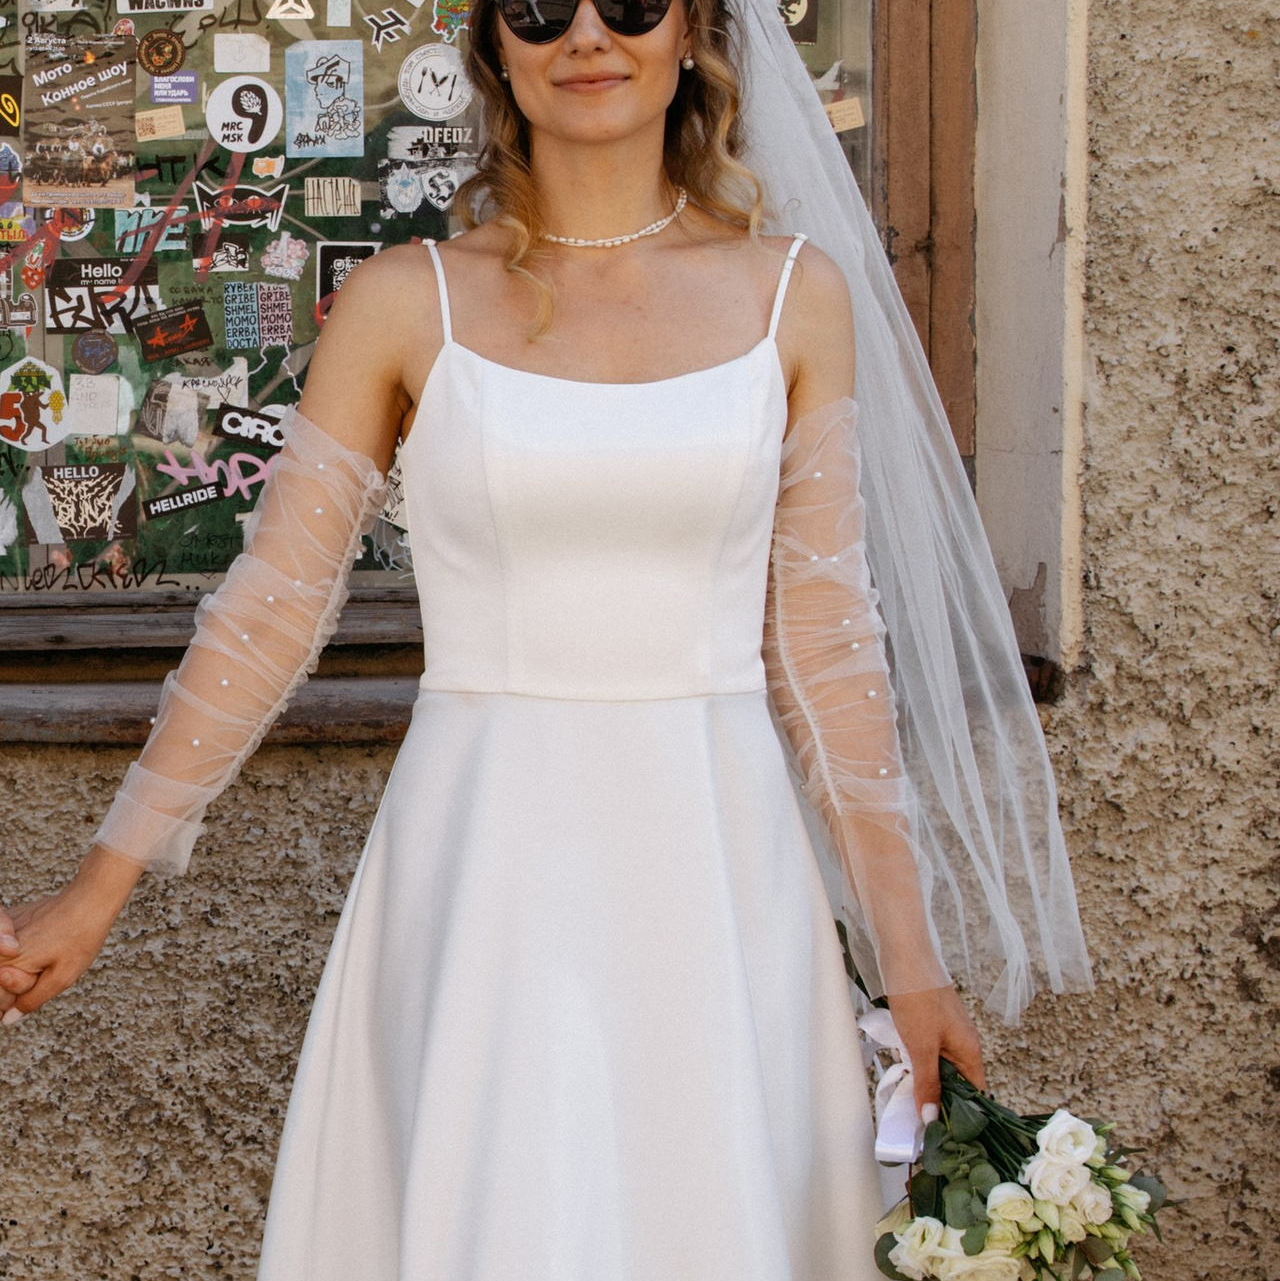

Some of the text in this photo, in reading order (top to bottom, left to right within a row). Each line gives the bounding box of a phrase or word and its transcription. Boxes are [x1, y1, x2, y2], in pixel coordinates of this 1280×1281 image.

[34, 37, 67, 47] Августа
[32, 63, 72, 87] Мото
[41, 76, 96, 107] Конное
[97, 61, 128, 82] шоу
[221, 121, 243, 131] MRC
[221, 133, 244, 143] MSK
[80, 263, 123, 278] Hello
[224, 293, 256, 305] GRIBE
[224, 304, 257, 316] SHMEL
[260, 303, 292, 313] SHMEL
[226, 315, 257, 327] MOMO
[260, 313, 292, 324] MOMO
[226, 327, 258, 338] ERRBA
[261, 324, 293, 335] ERRBA
[227, 337, 259, 350] DOCTA
[53, 466, 99, 480] HELLO
[149, 485, 218, 515] HELLRIDE
